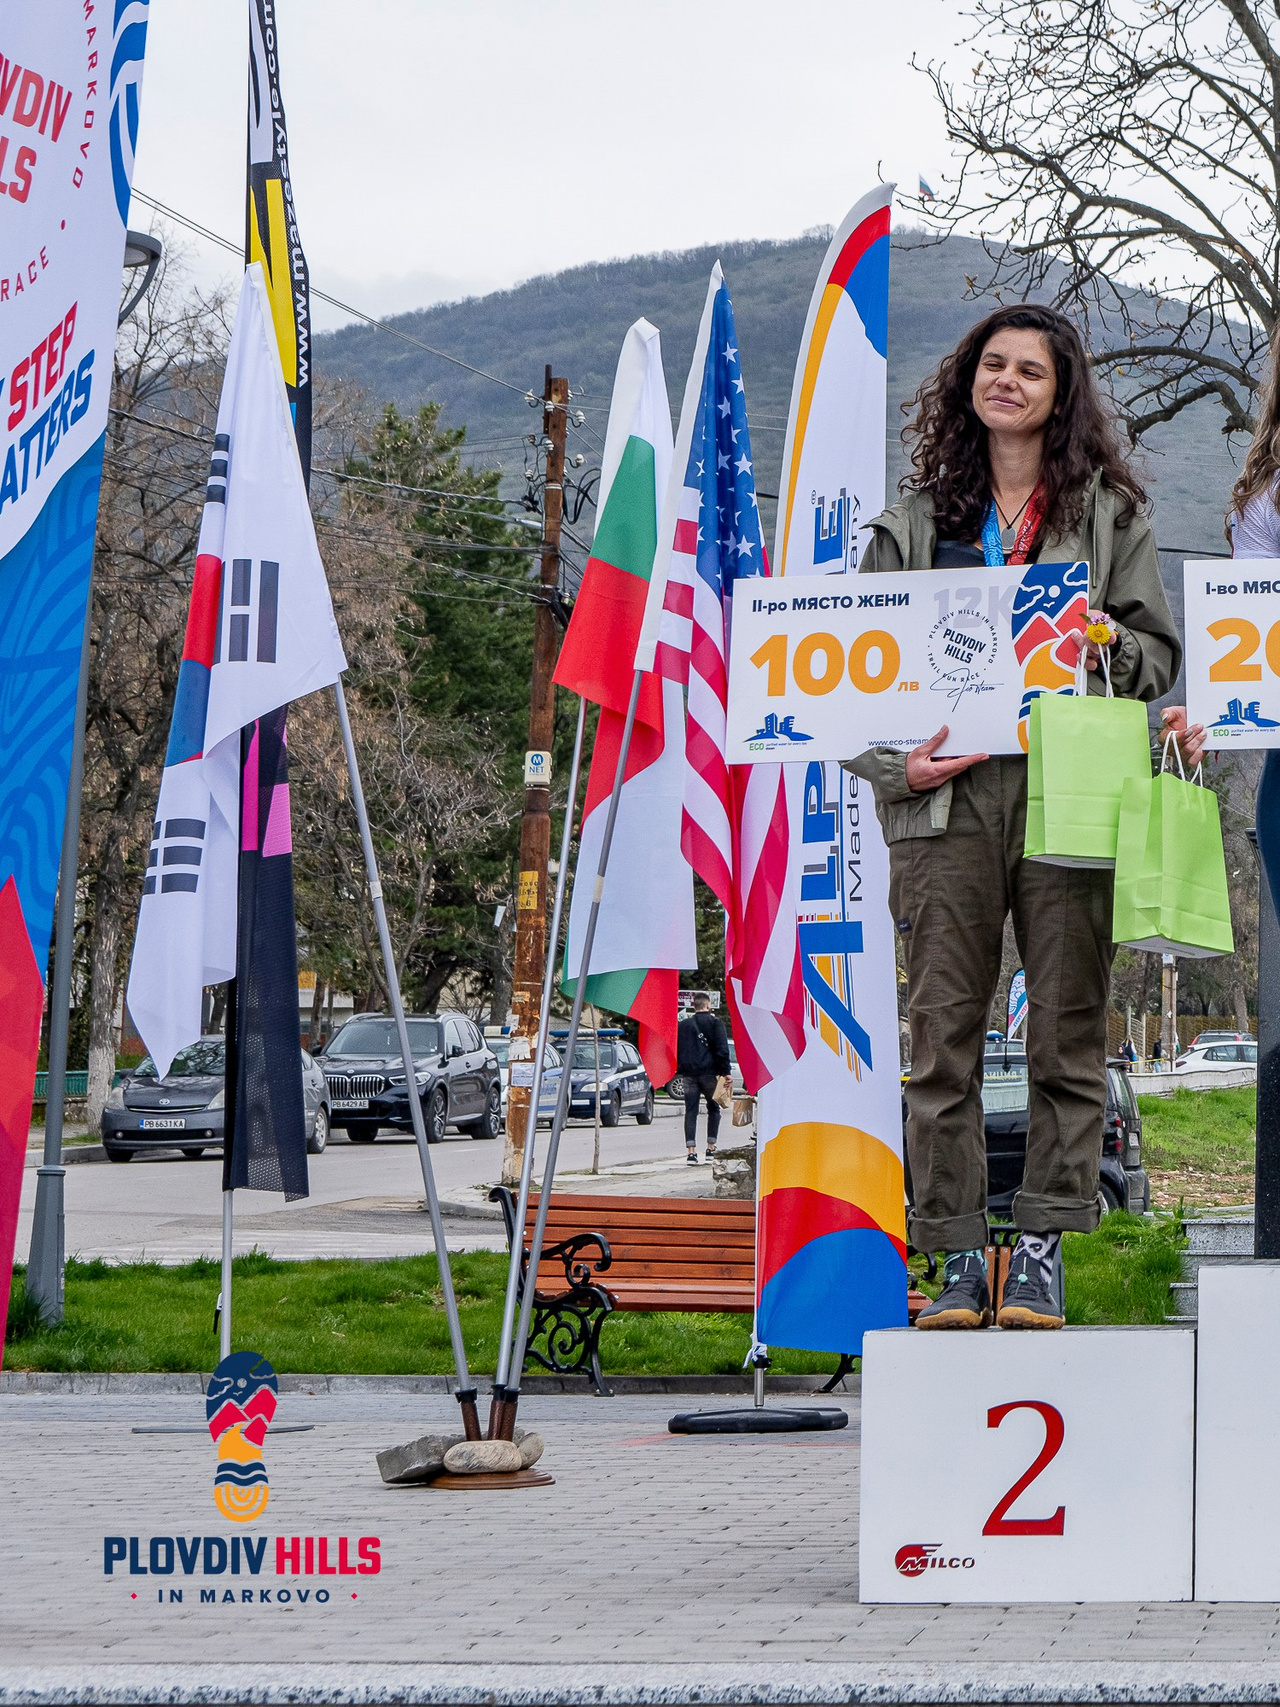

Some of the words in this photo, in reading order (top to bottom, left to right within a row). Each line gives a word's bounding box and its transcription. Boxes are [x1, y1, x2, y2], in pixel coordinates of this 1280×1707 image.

[0, 52, 73, 143] VDIV
[8, 300, 78, 432] STEP
[792, 595, 853, 611] МЯСТО
[857, 593, 909, 608] ЖЕНИ
[934, 586, 1020, 630] 12K
[928, 611, 955, 639] PLOVDIV
[958, 609, 980, 617] HILLS
[981, 616, 990, 624] IN
[988, 625, 998, 664] MARKOVO
[943, 628, 986, 653] PLOVDIV
[749, 629, 900, 696] 100
[897, 681, 920, 692] лв
[927, 652, 941, 674] TRAIL
[944, 644, 973, 664] HILLS
[868, 738, 929, 747] www.eco-steam
[1213, 729, 1229, 737] ECO
[750, 742, 765, 751] ECO
[982, 1400, 1066, 1536] 2
